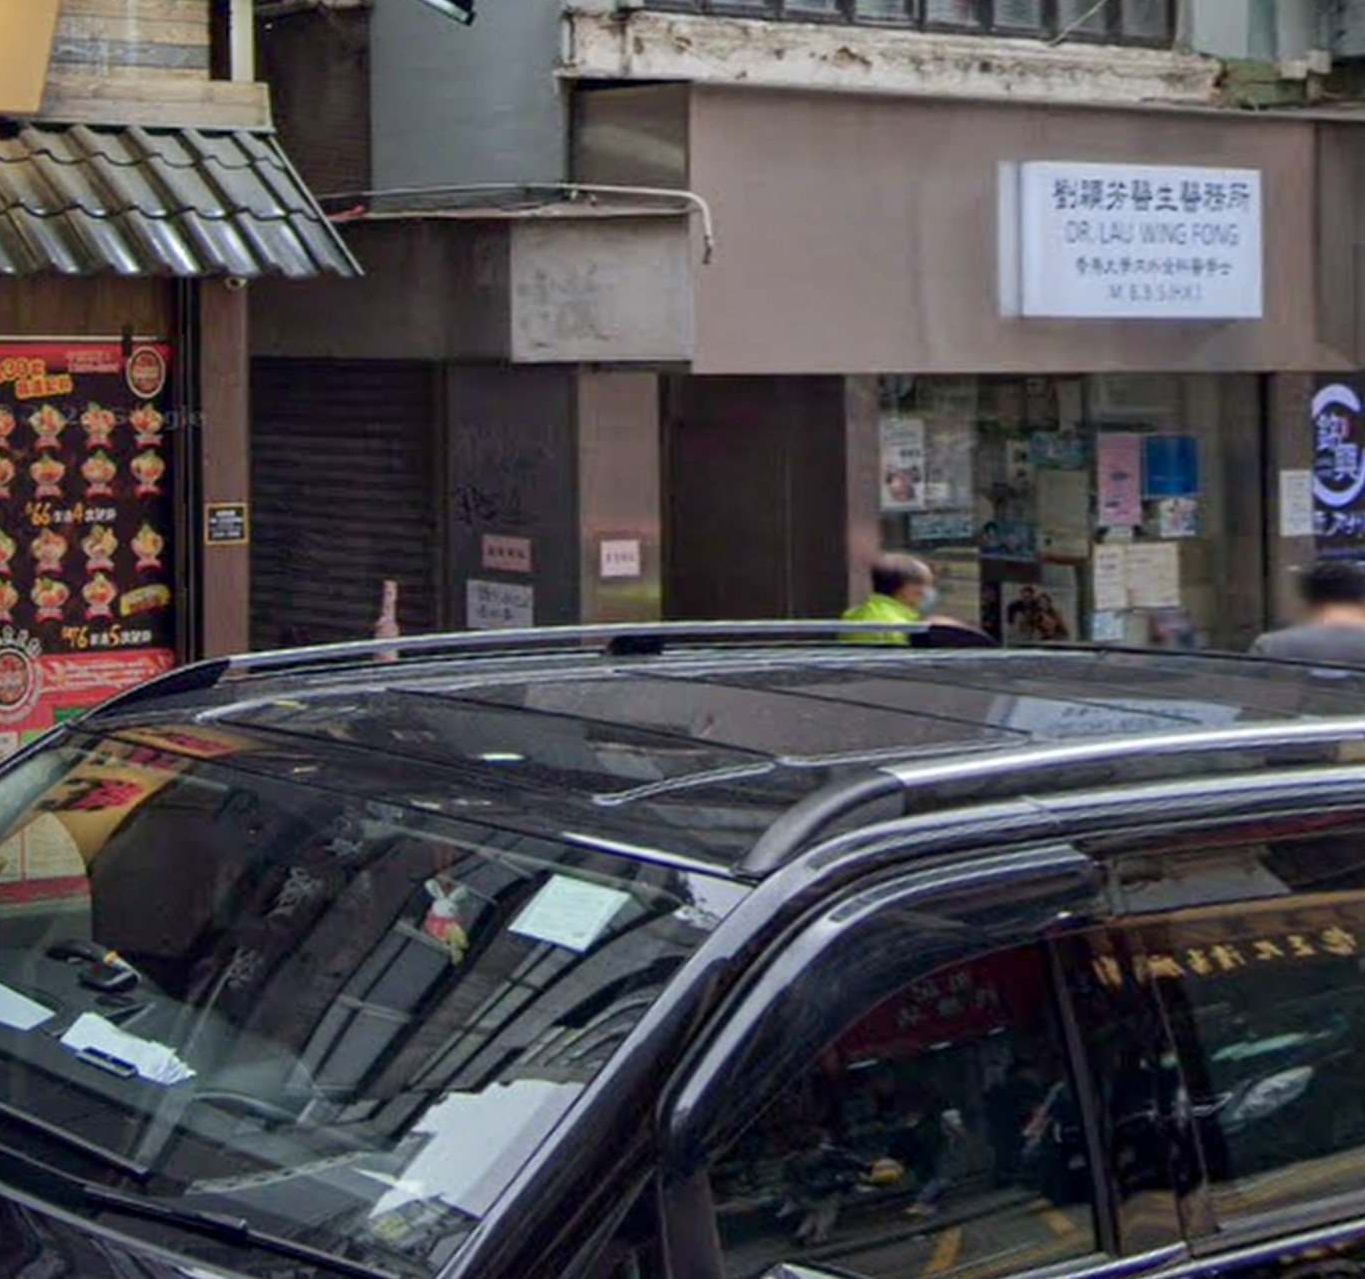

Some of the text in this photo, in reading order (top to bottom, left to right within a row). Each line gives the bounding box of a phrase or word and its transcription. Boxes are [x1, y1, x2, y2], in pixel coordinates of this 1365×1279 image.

[1100, 222, 1135, 245] LAU
[1139, 222, 1187, 246] WING
[1191, 222, 1240, 246] FONG
